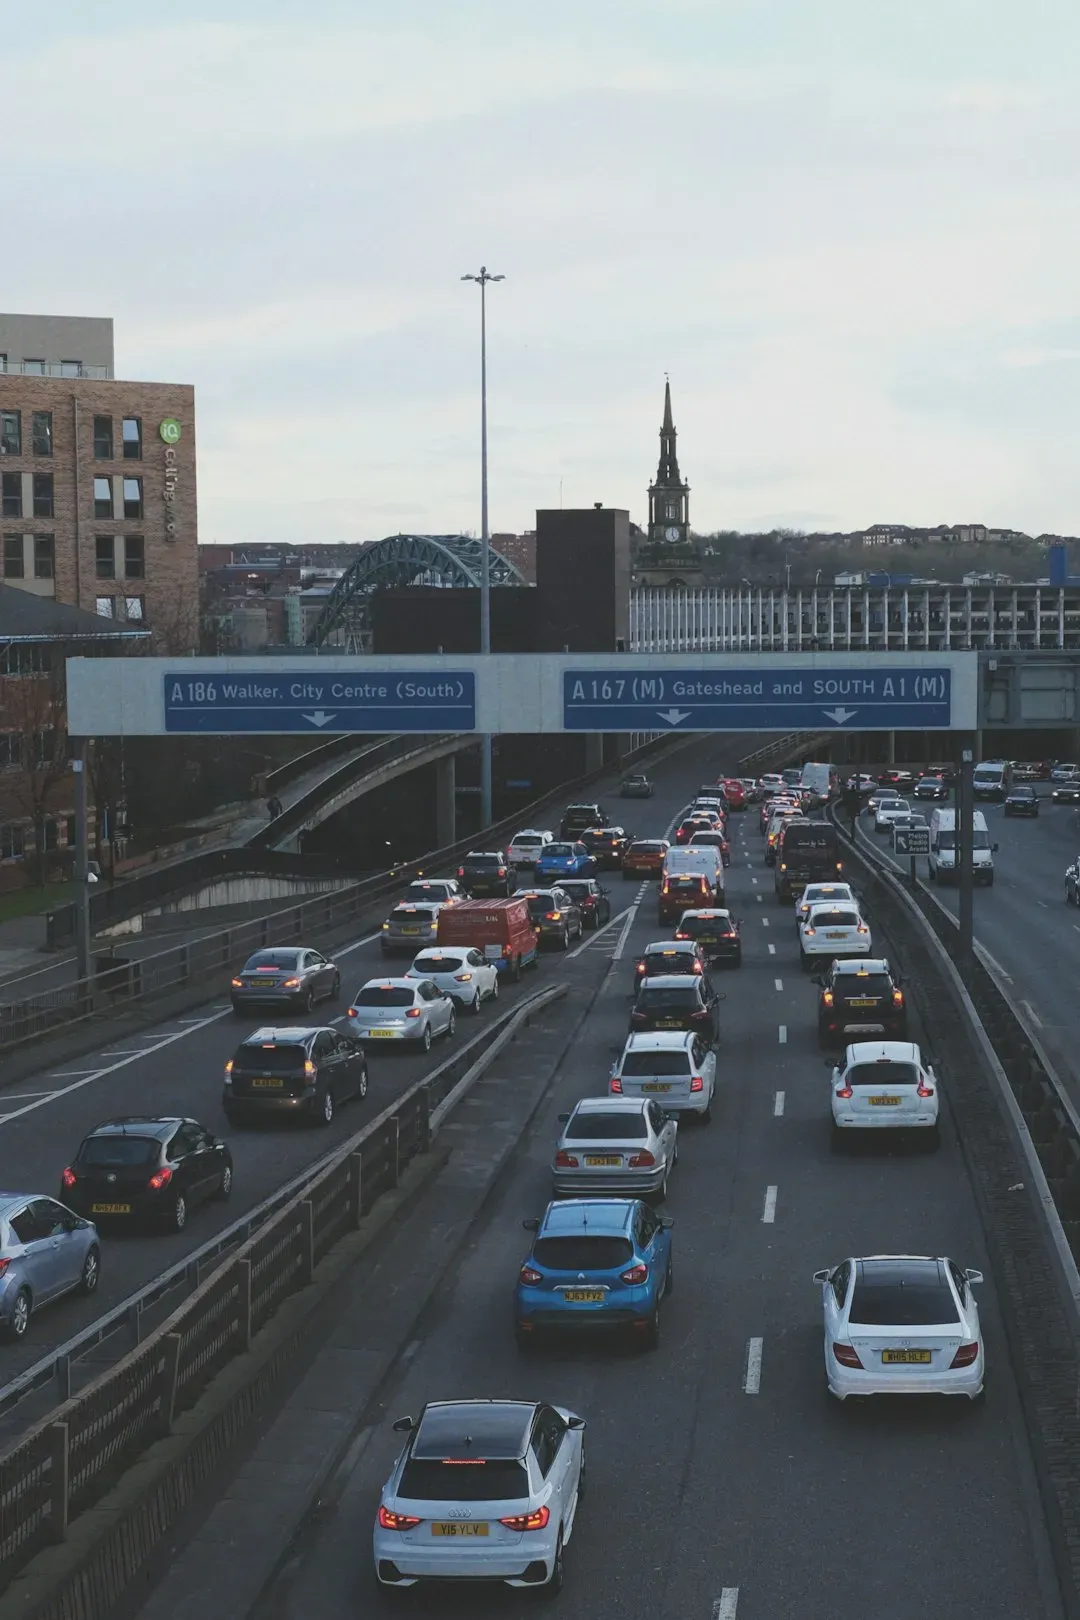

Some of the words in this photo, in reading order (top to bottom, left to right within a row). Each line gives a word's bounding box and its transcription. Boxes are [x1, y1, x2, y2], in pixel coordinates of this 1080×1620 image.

[163, 423, 178, 438] iQ
[291, 684, 323, 700] City
[331, 683, 387, 698] Centre
[396, 681, 463, 699] (South)
[673, 681, 763, 695] Gateshead
[772, 681, 802, 695] and
[813, 680, 874, 694] SOUTH
[459, 1524, 479, 1535] YLV
